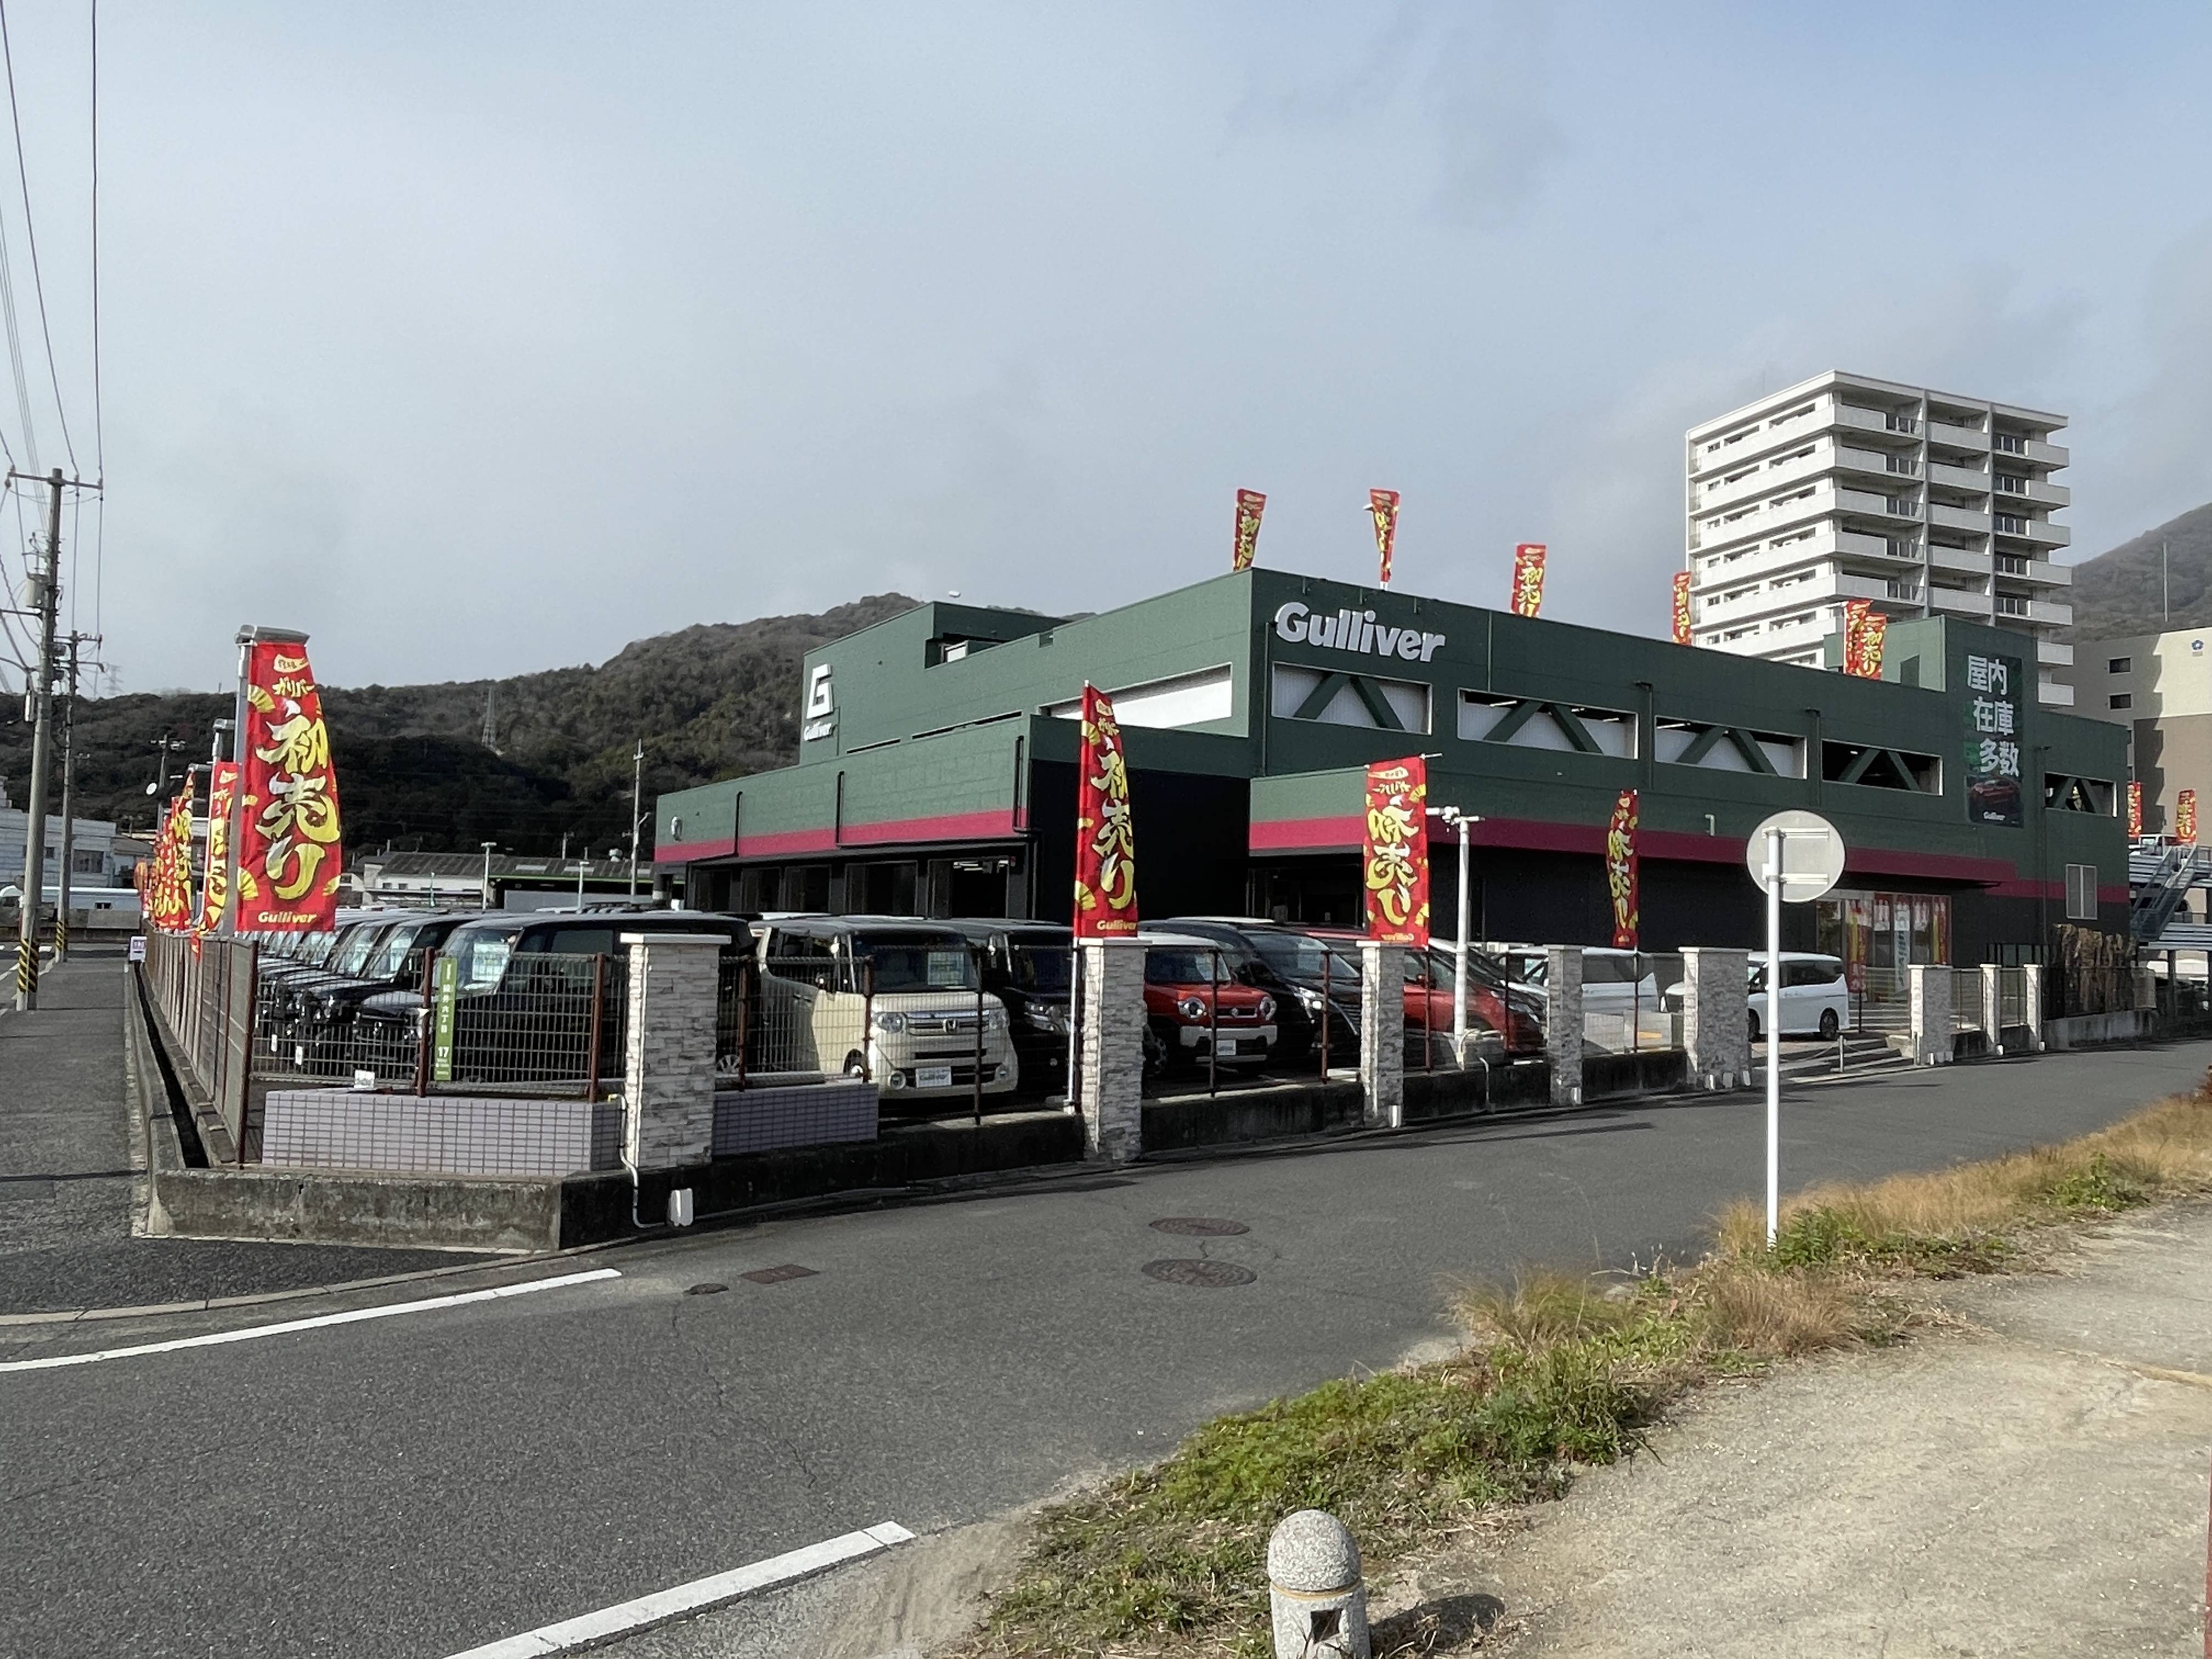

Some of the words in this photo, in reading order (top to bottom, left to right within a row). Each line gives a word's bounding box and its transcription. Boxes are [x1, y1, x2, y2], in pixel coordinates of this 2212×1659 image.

[1274, 602, 1446, 662] Gulliver
[1968, 655, 2007, 696] 屋内
[1973, 696, 2014, 736] 在庫
[1979, 738, 2019, 777] 多数
[255, 698, 340, 900] 初売り
[258, 911, 317, 923] Gulliver
[438, 1046, 449, 1058] 17
